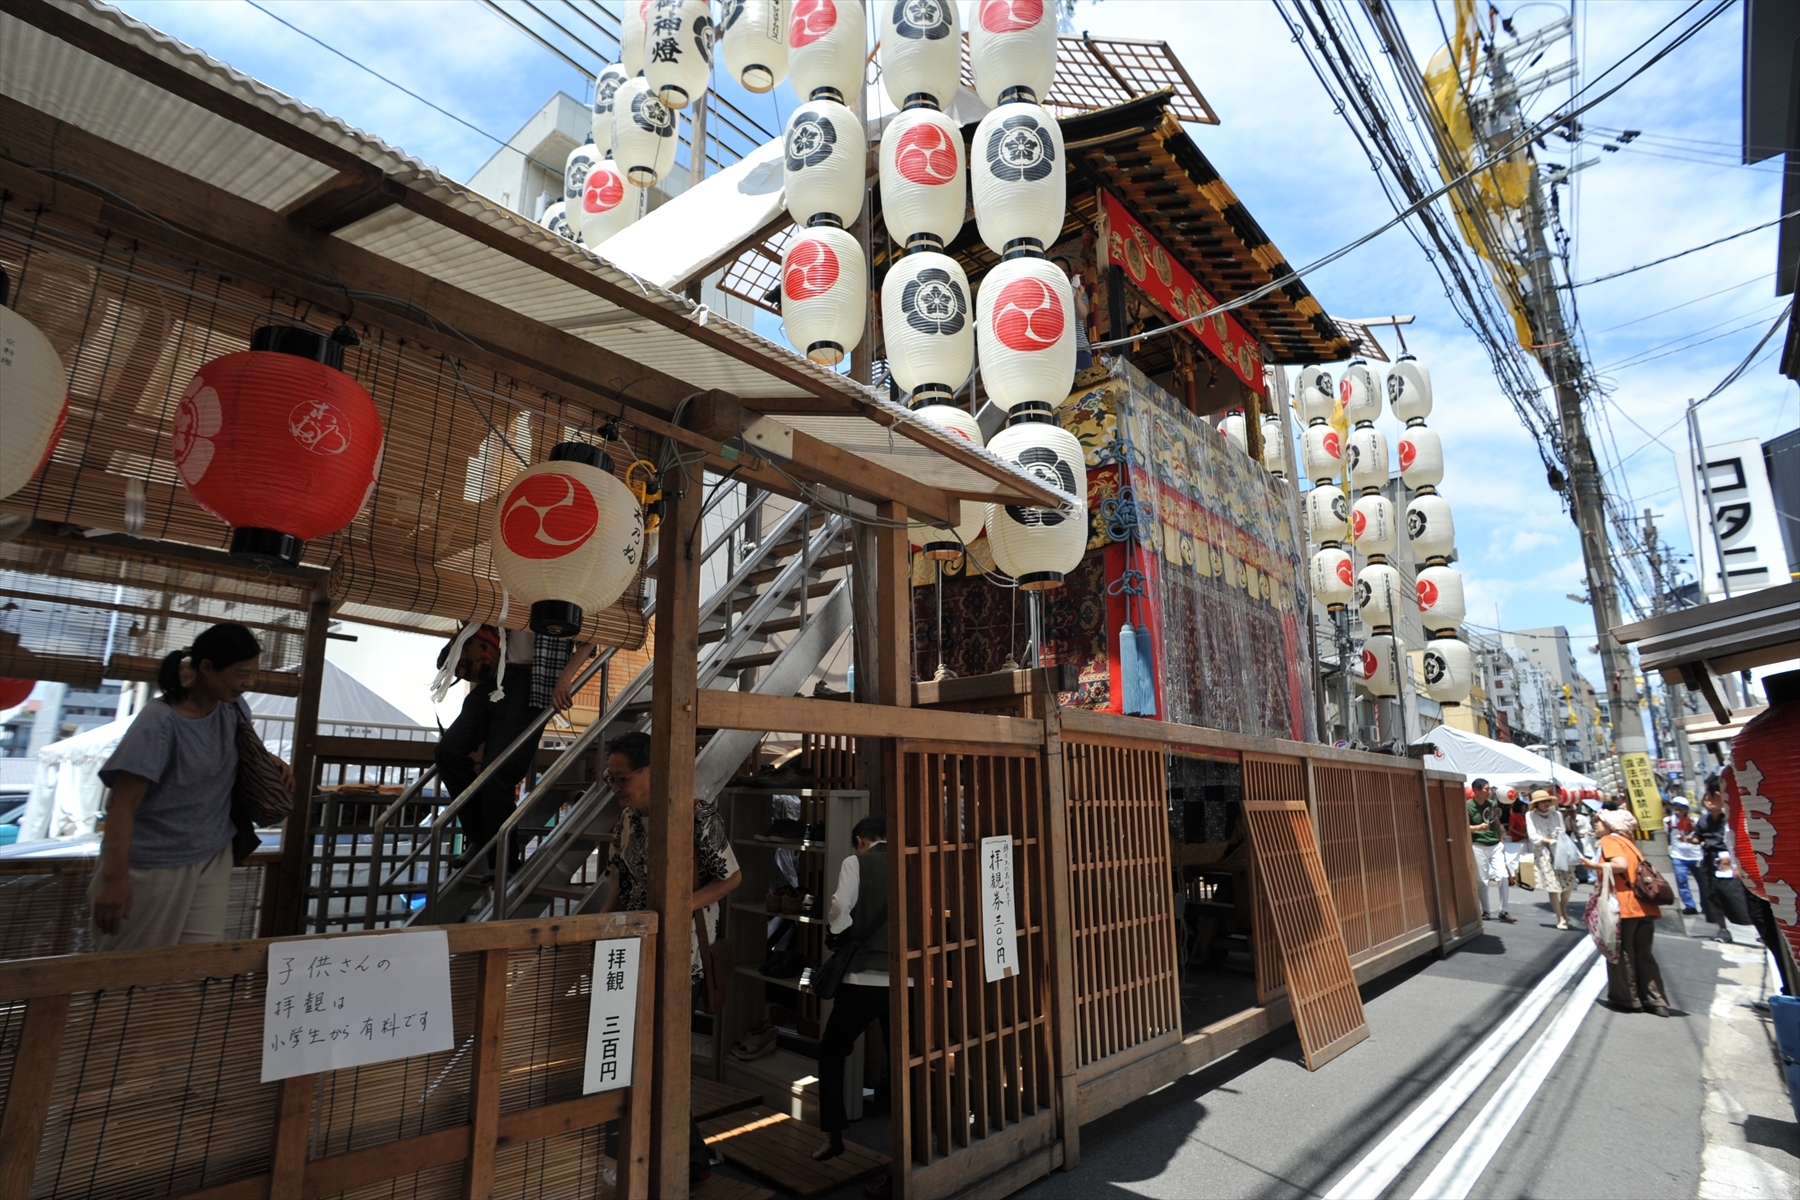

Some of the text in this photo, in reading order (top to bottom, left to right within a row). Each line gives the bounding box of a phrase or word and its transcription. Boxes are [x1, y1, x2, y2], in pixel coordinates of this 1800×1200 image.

[1696, 456, 1769, 578] コタニ
[1623, 758, 1652, 819] 違法駐車禁止
[1635, 757, 1654, 787] 通学路
[278, 955, 391, 986] 子供さんの
[273, 991, 346, 1020] 拝観は
[599, 948, 627, 1083] 拝観 三百円
[270, 1010, 429, 1052] 小学生から有料です
